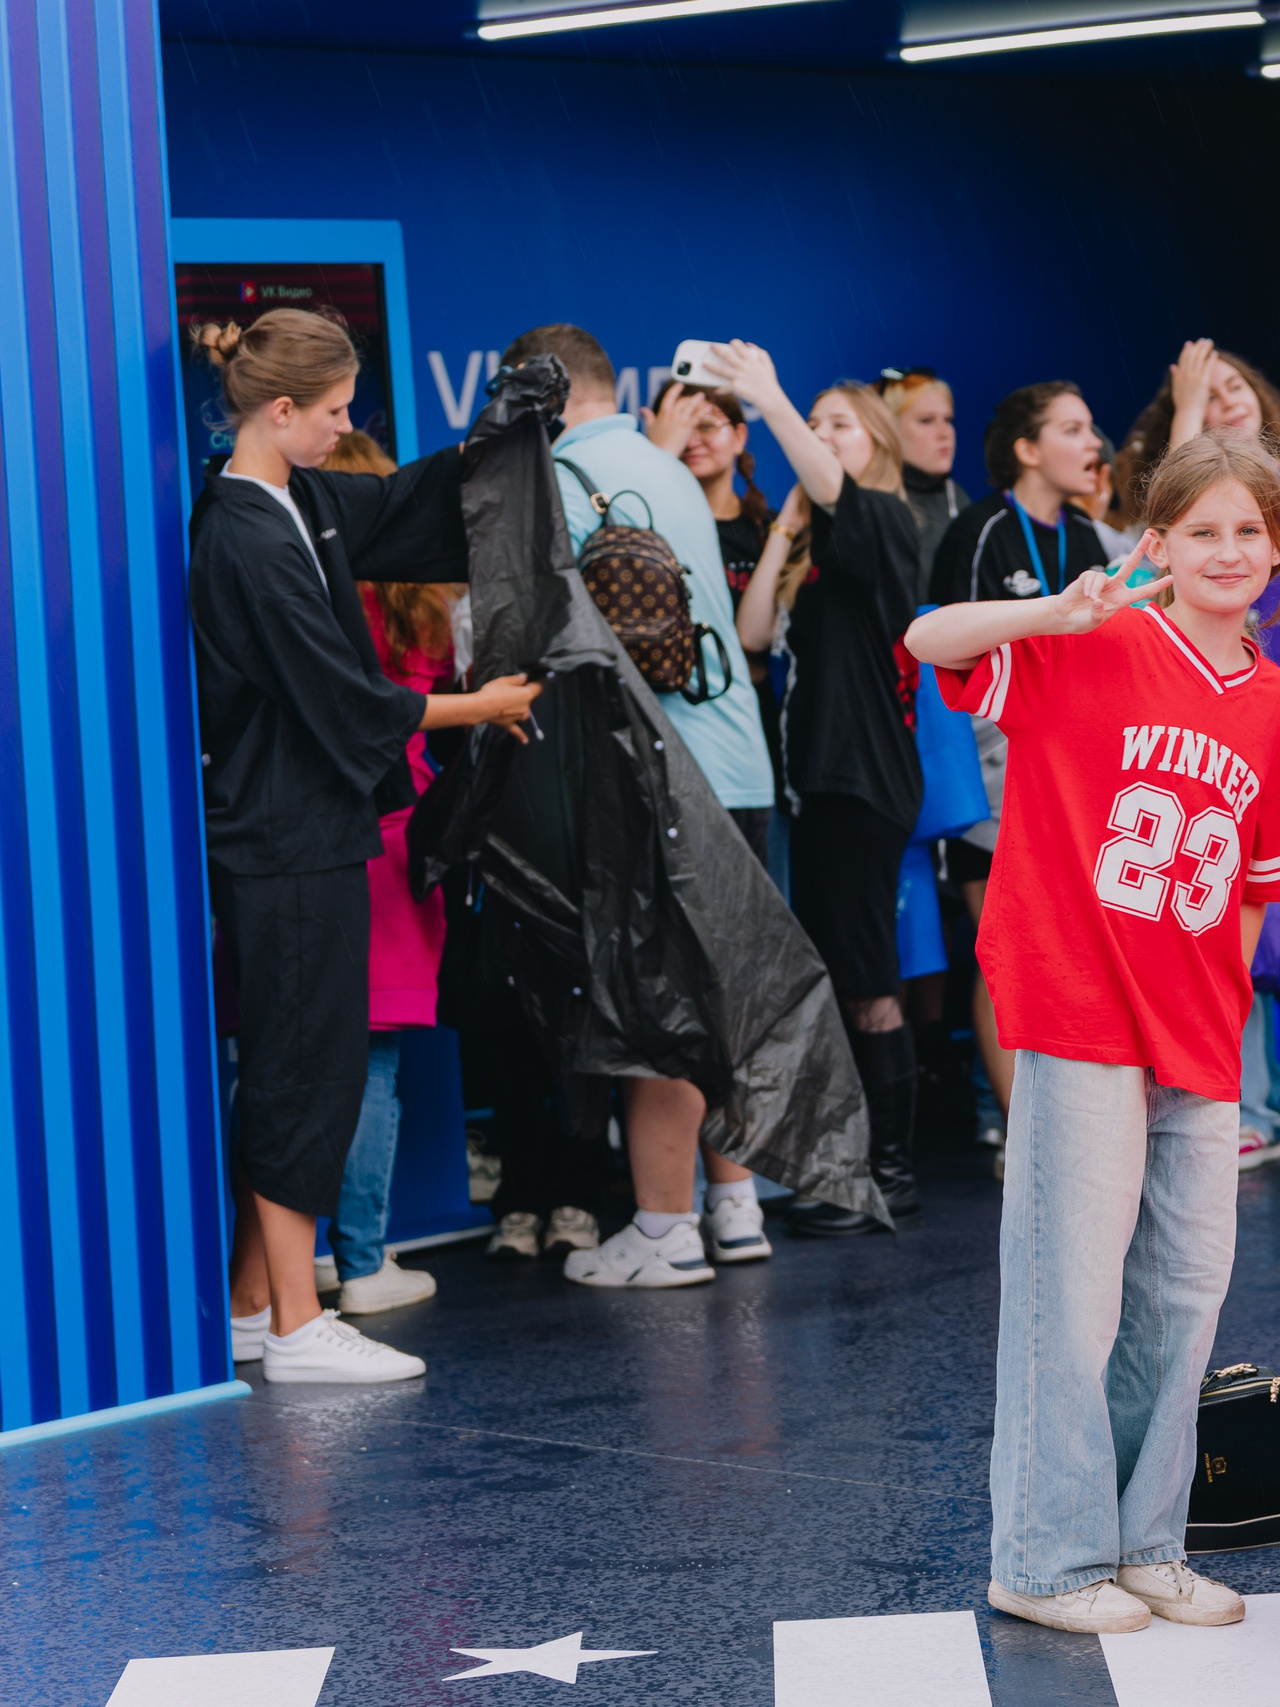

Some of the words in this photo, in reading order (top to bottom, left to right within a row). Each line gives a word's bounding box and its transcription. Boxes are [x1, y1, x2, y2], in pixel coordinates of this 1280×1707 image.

[261, 285, 276, 298] VK
[278, 285, 312, 299] Видео
[427, 350, 500, 430] V
[1121, 725, 1260, 825] WINNER
[1093, 781, 1241, 937] 23
